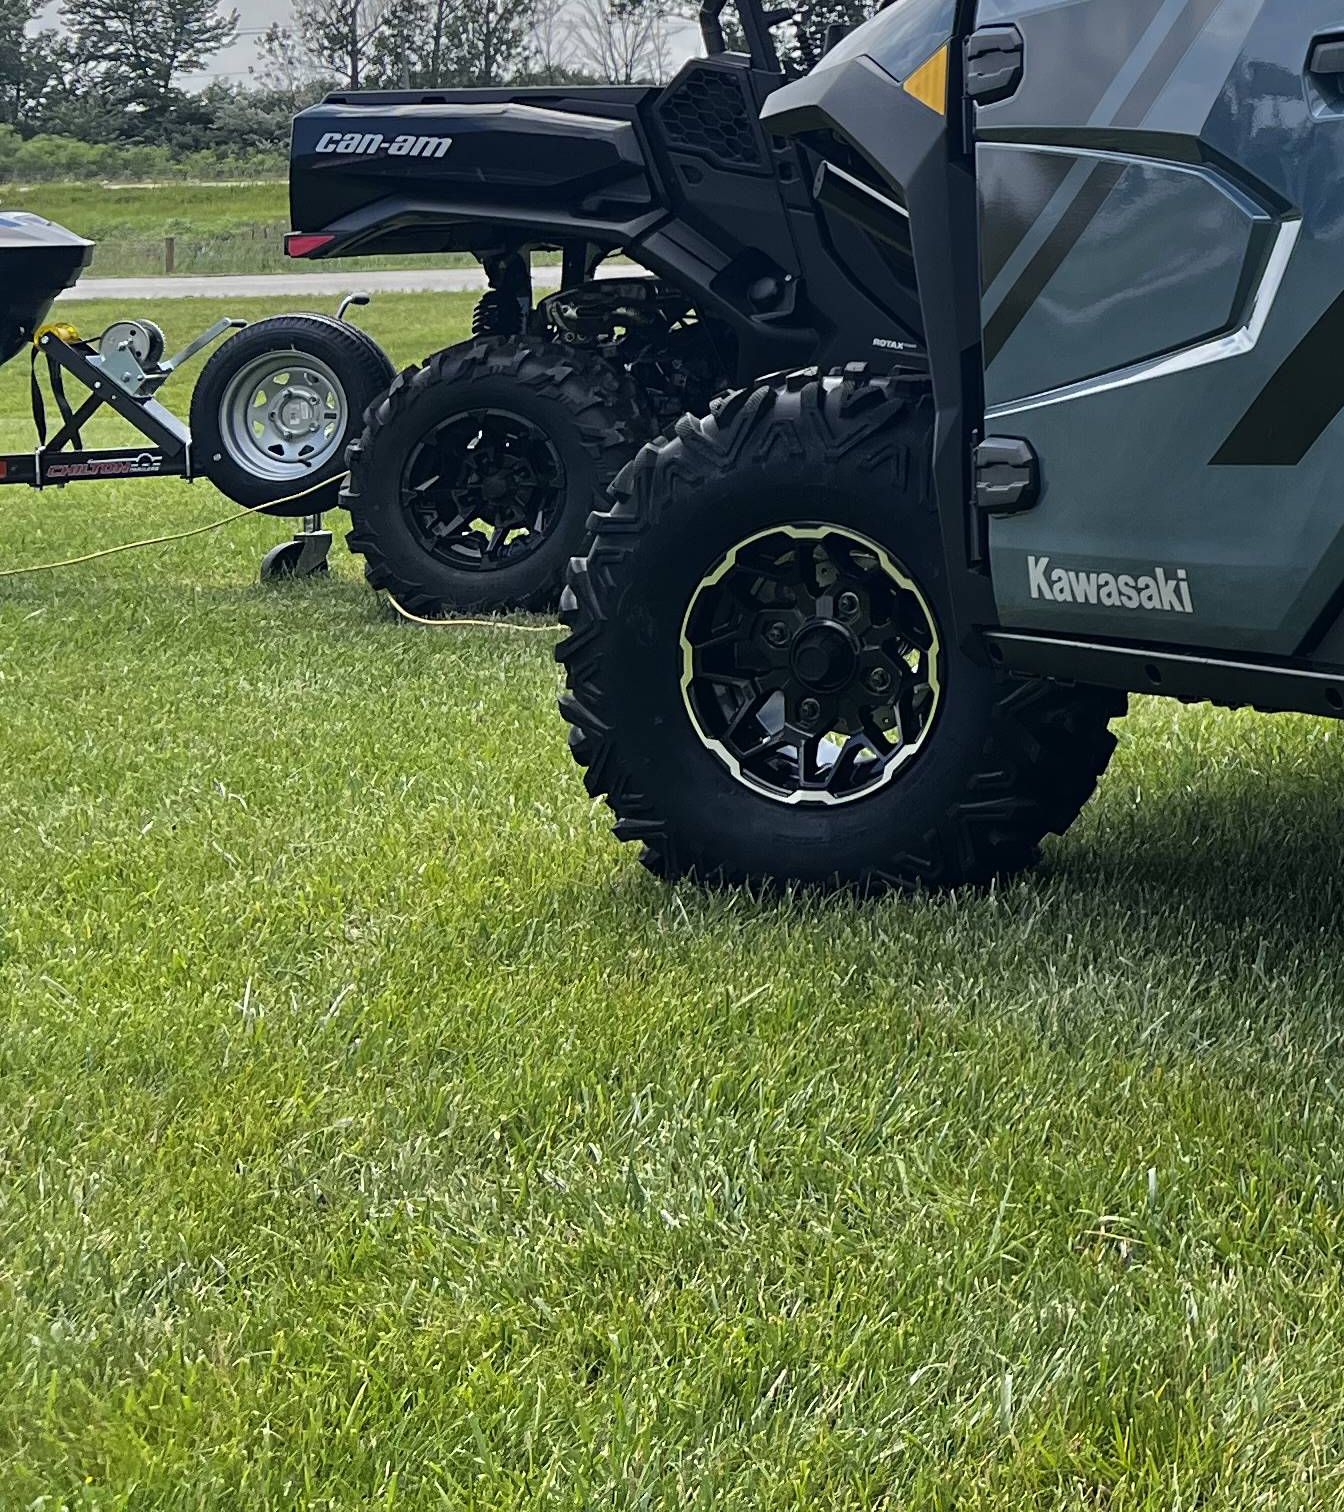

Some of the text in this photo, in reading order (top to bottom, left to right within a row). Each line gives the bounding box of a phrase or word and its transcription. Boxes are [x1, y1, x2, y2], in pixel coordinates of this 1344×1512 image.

[315, 132, 453, 158] can-am
[872, 338, 904, 349] ROTAX
[1027, 556, 1193, 613] Kawasaki
